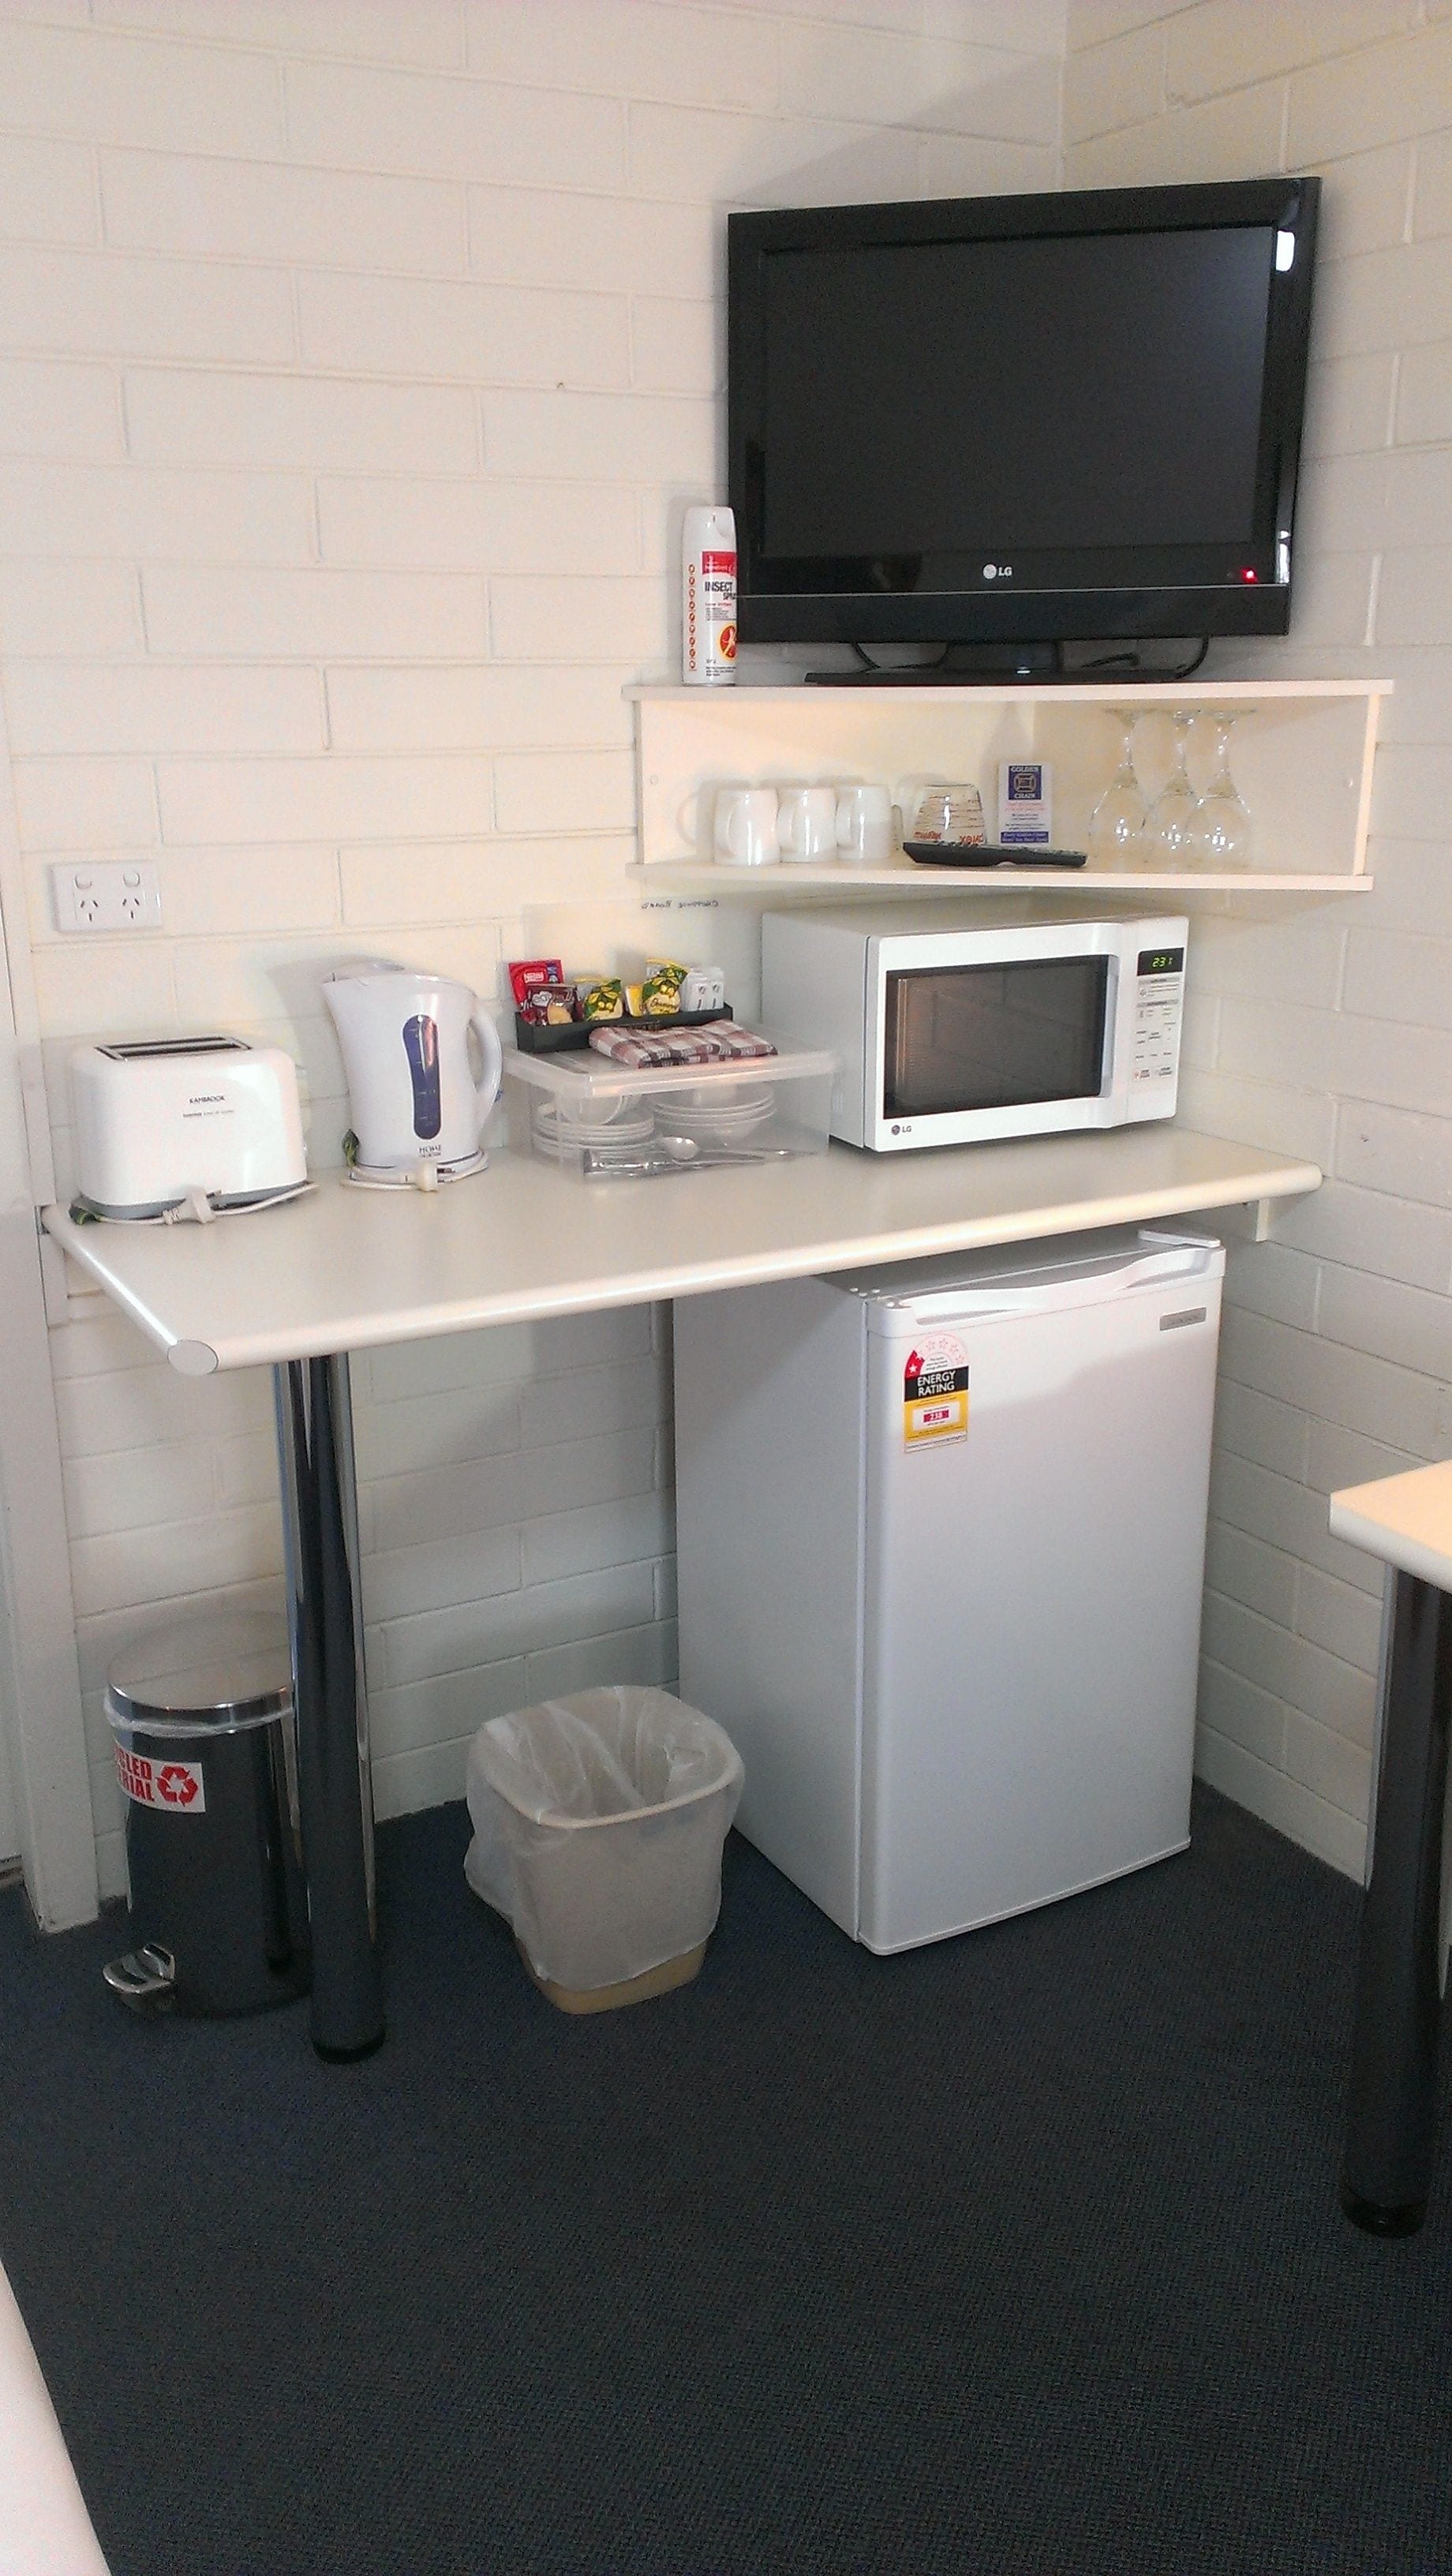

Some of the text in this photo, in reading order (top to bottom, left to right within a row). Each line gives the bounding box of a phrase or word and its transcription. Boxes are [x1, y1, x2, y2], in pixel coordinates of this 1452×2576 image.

[998, 566, 1012, 577] LG
[705, 581, 733, 592] INSECT
[917, 1370, 956, 1387] ENERGY
[918, 1380, 956, 1398] RATING
[117, 1745, 152, 1781] CLED
